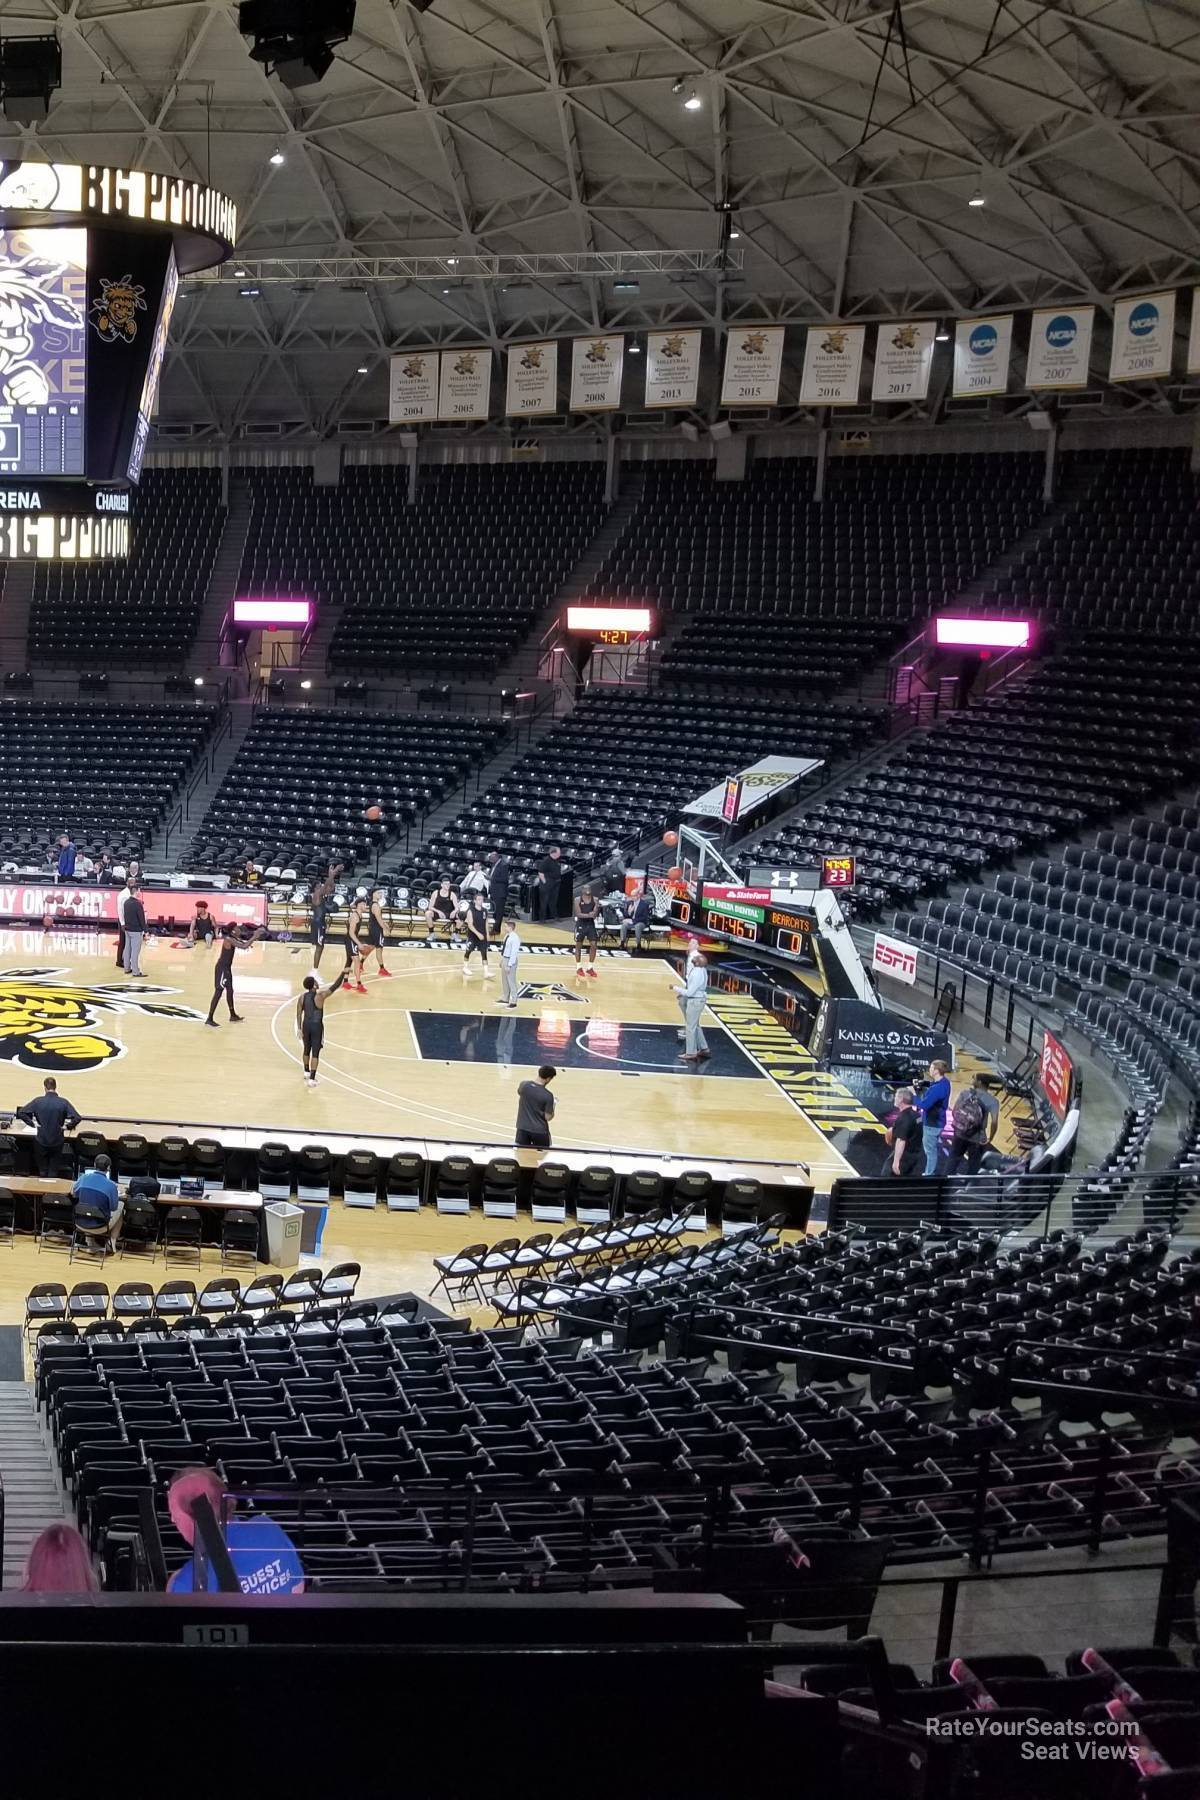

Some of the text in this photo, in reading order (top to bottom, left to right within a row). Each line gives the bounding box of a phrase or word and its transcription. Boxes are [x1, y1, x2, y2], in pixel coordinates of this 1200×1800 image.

[1128, 358, 1154, 370] 2008
[1045, 368, 1072, 380] 2007
[969, 376, 992, 387] 2004
[660, 389, 681, 399] 2013
[739, 386, 761, 396] 2015
[818, 387, 841, 397] 2016
[888, 384, 912, 394] 2017
[521, 398, 542, 408] 2007
[584, 393, 606, 402] 2008
[403, 407, 423, 416] 2004
[453, 405, 474, 414] 2005
[600, 631, 628, 644] 4:27
[829, 870, 847, 882] 23
[709, 913, 744, 937] 47:46
[772, 912, 810, 931] BEARCATS
[791, 935, 800, 952] 0
[875, 942, 916, 974] ESPN
[838, 1029, 935, 1047] KANSAS STAR
[768, 1069, 889, 1135] STATE
[241, 1559, 282, 1594] GUEST
[196, 1627, 239, 1644] 101
